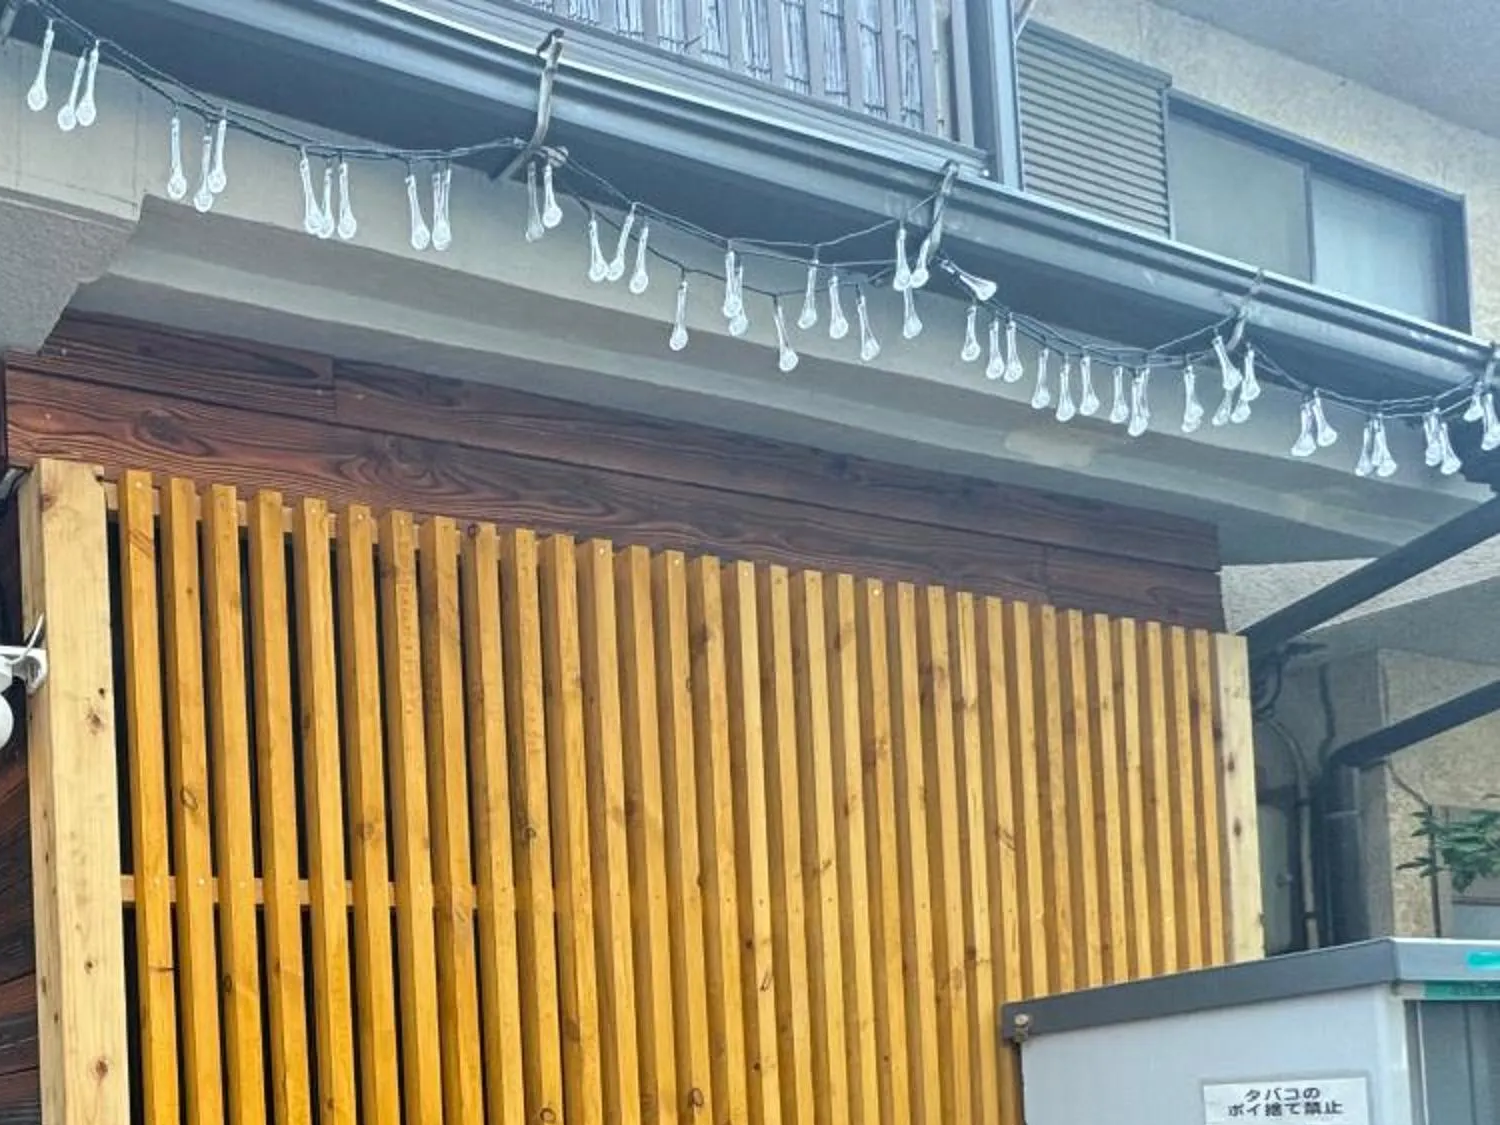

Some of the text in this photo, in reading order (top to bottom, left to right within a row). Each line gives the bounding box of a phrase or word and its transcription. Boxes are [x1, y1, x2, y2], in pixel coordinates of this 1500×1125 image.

[1245, 1086, 1321, 1101] タバコの
[1227, 1099, 1344, 1118] ポイ捨て禁止
